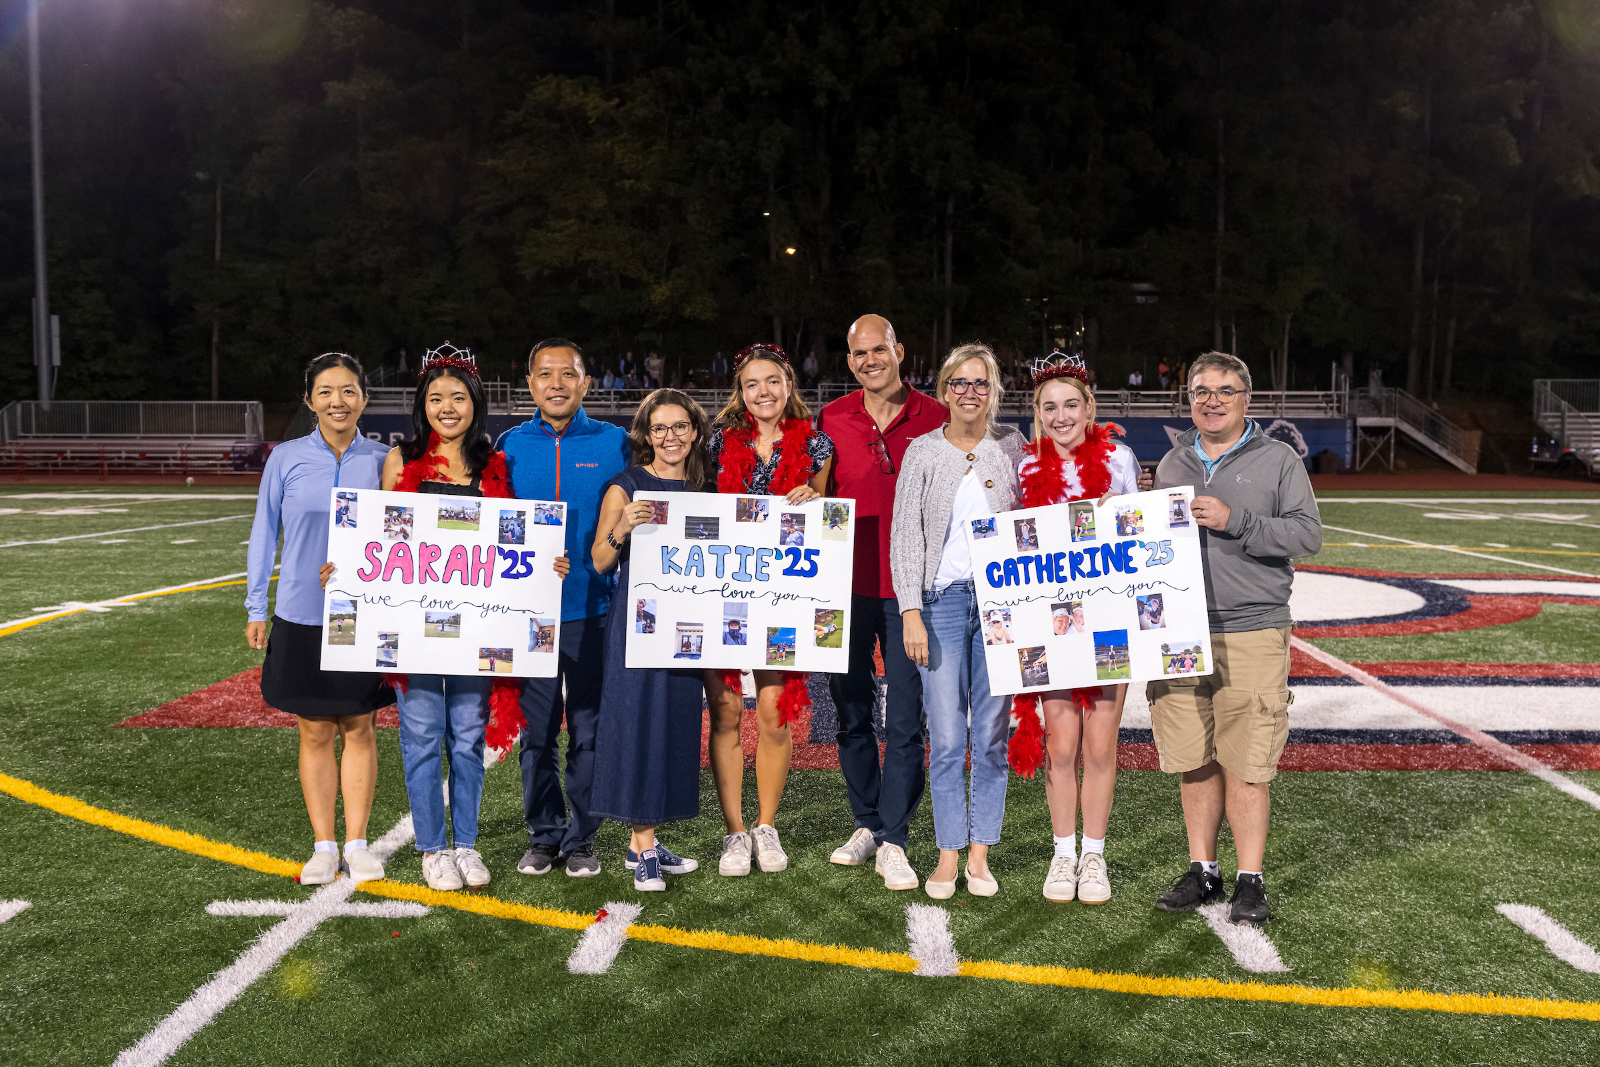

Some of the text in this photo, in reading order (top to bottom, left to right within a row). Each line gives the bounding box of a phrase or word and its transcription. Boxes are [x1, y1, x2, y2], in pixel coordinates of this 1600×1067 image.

[357, 541, 496, 588] SARAH
[661, 544, 774, 582] KATIE
[985, 539, 1138, 589] CATHERINE
[419, 594, 456, 611] love
[479, 601, 511, 618] you
[721, 582, 757, 600] love
[773, 589, 802, 606] you
[1056, 587, 1093, 603] love
[1126, 581, 1157, 599] you
